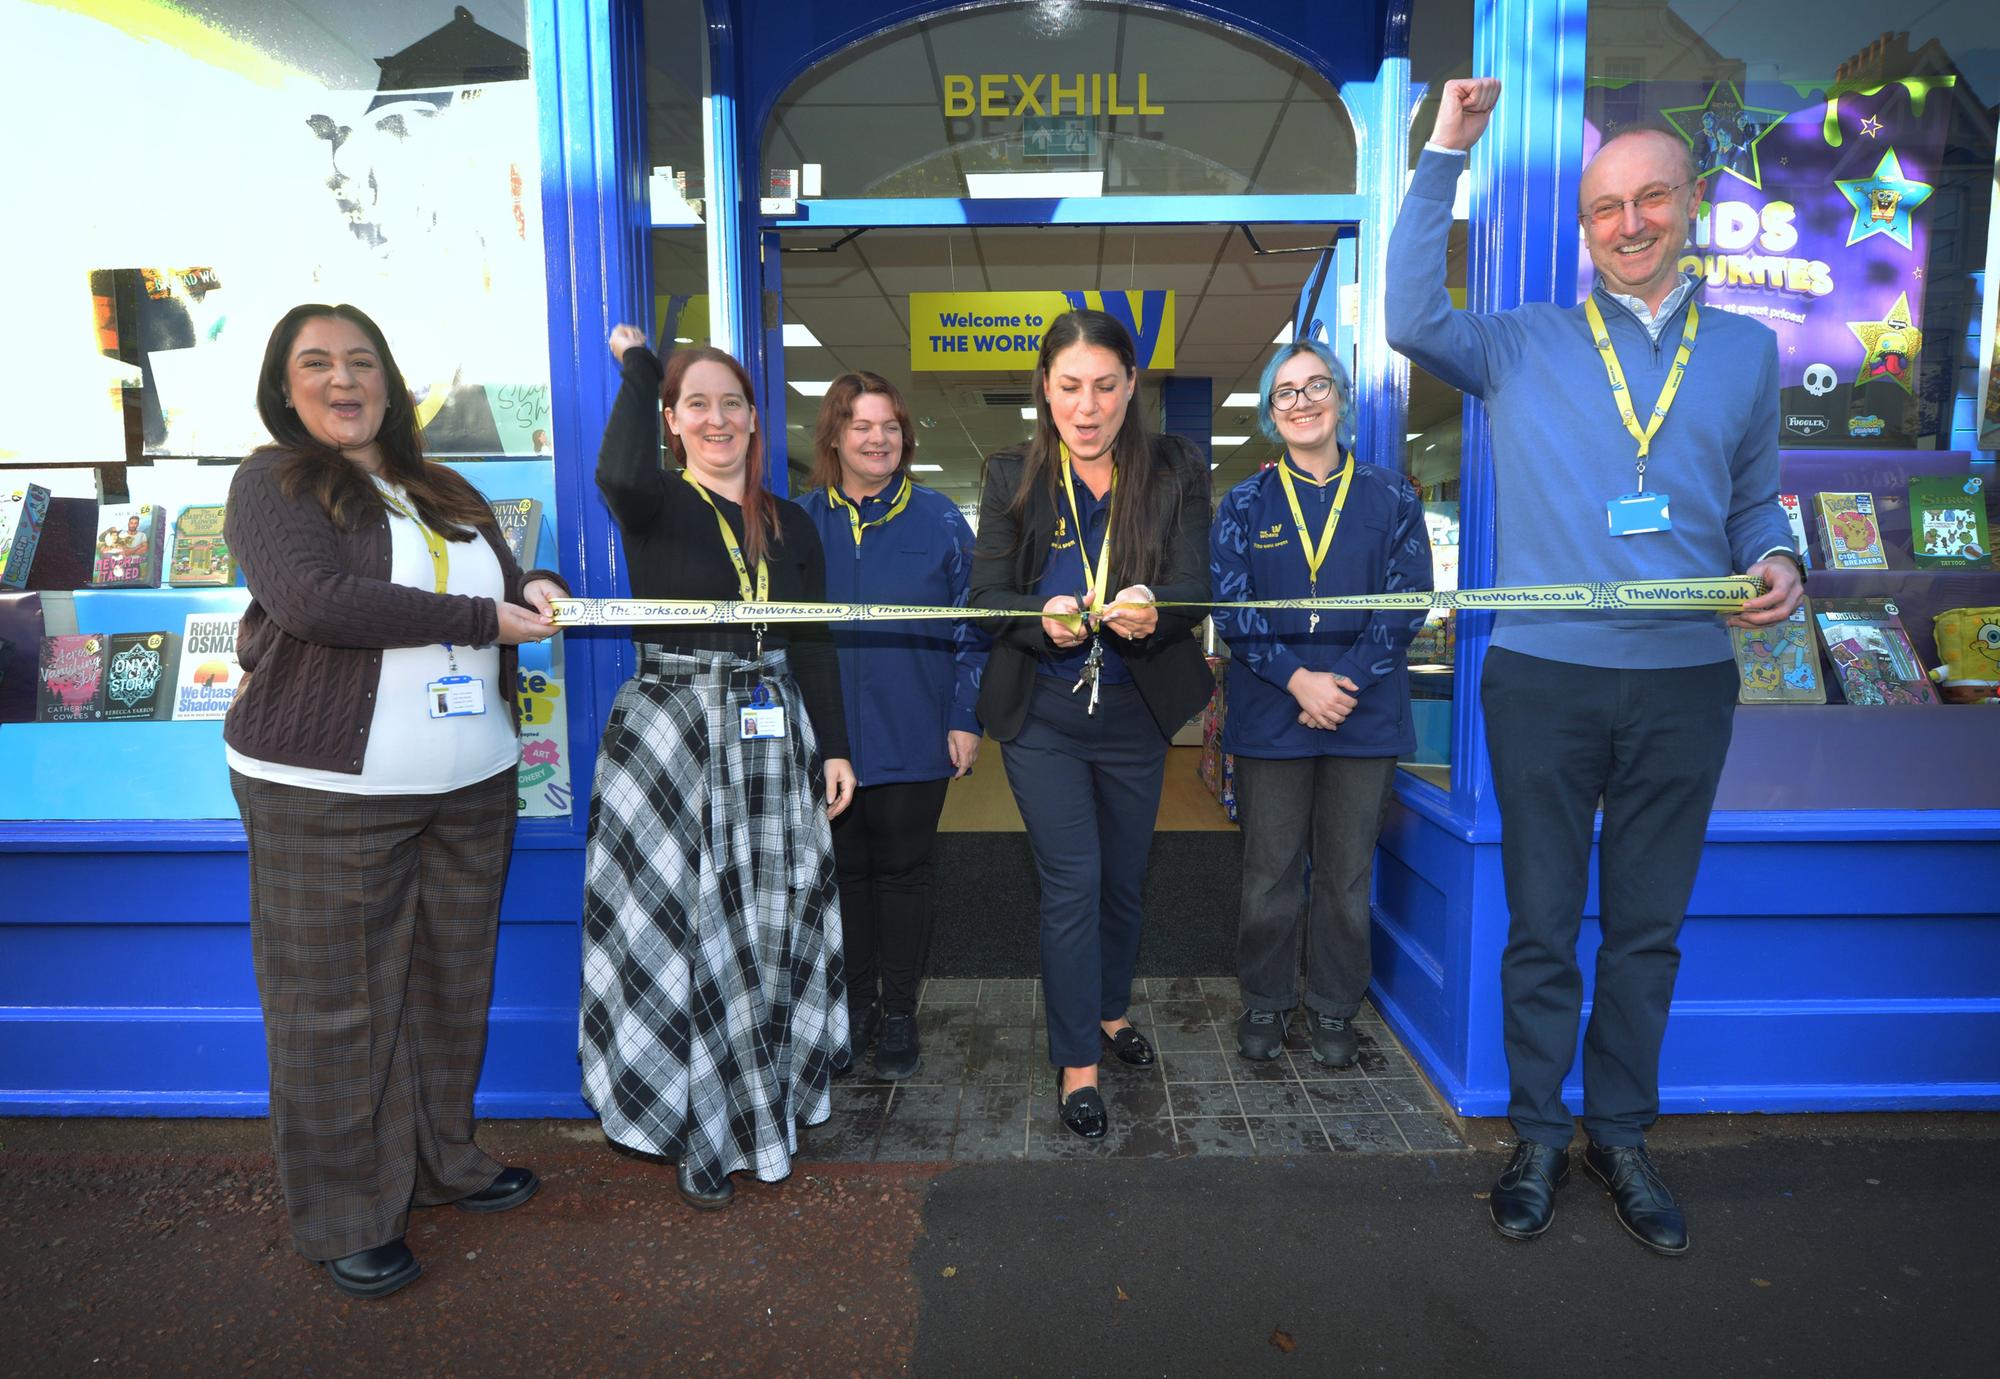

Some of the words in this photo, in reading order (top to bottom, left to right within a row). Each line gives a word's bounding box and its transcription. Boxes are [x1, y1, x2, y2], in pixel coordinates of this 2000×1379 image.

[944, 73, 1165, 117] BEXHILL
[1684, 200, 1799, 252] IDS
[1677, 254, 1834, 296] OURITES
[939, 312, 1021, 327] Welcome
[1025, 313, 1043, 327] to
[1738, 305, 1769, 317] great
[1770, 308, 1806, 324] prices!
[929, 335, 968, 352] THE
[973, 334, 1044, 352] WORK
[1788, 417, 1826, 428] FUGGLER
[1843, 557, 1882, 566] BREAKERS
[1463, 589, 1585, 602] TheWorks.co.uk
[1624, 586, 1749, 601] TheWorks.co.uk
[741, 606, 842, 615] TheWorks.co.uk
[877, 606, 982, 614] TheWorks.co.uk
[187, 636, 238, 654] OSMA
[115, 657, 156, 673] ONYX
[111, 679, 154, 692] STORM
[518, 671, 548, 694] te
[181, 686, 199, 700] We
[47, 704, 95, 713] CATHERINE
[179, 699, 231, 712] Shadow
[53, 712, 89, 721] COWLES
[532, 749, 551, 759] ART
[518, 768, 546, 783] ONERY
